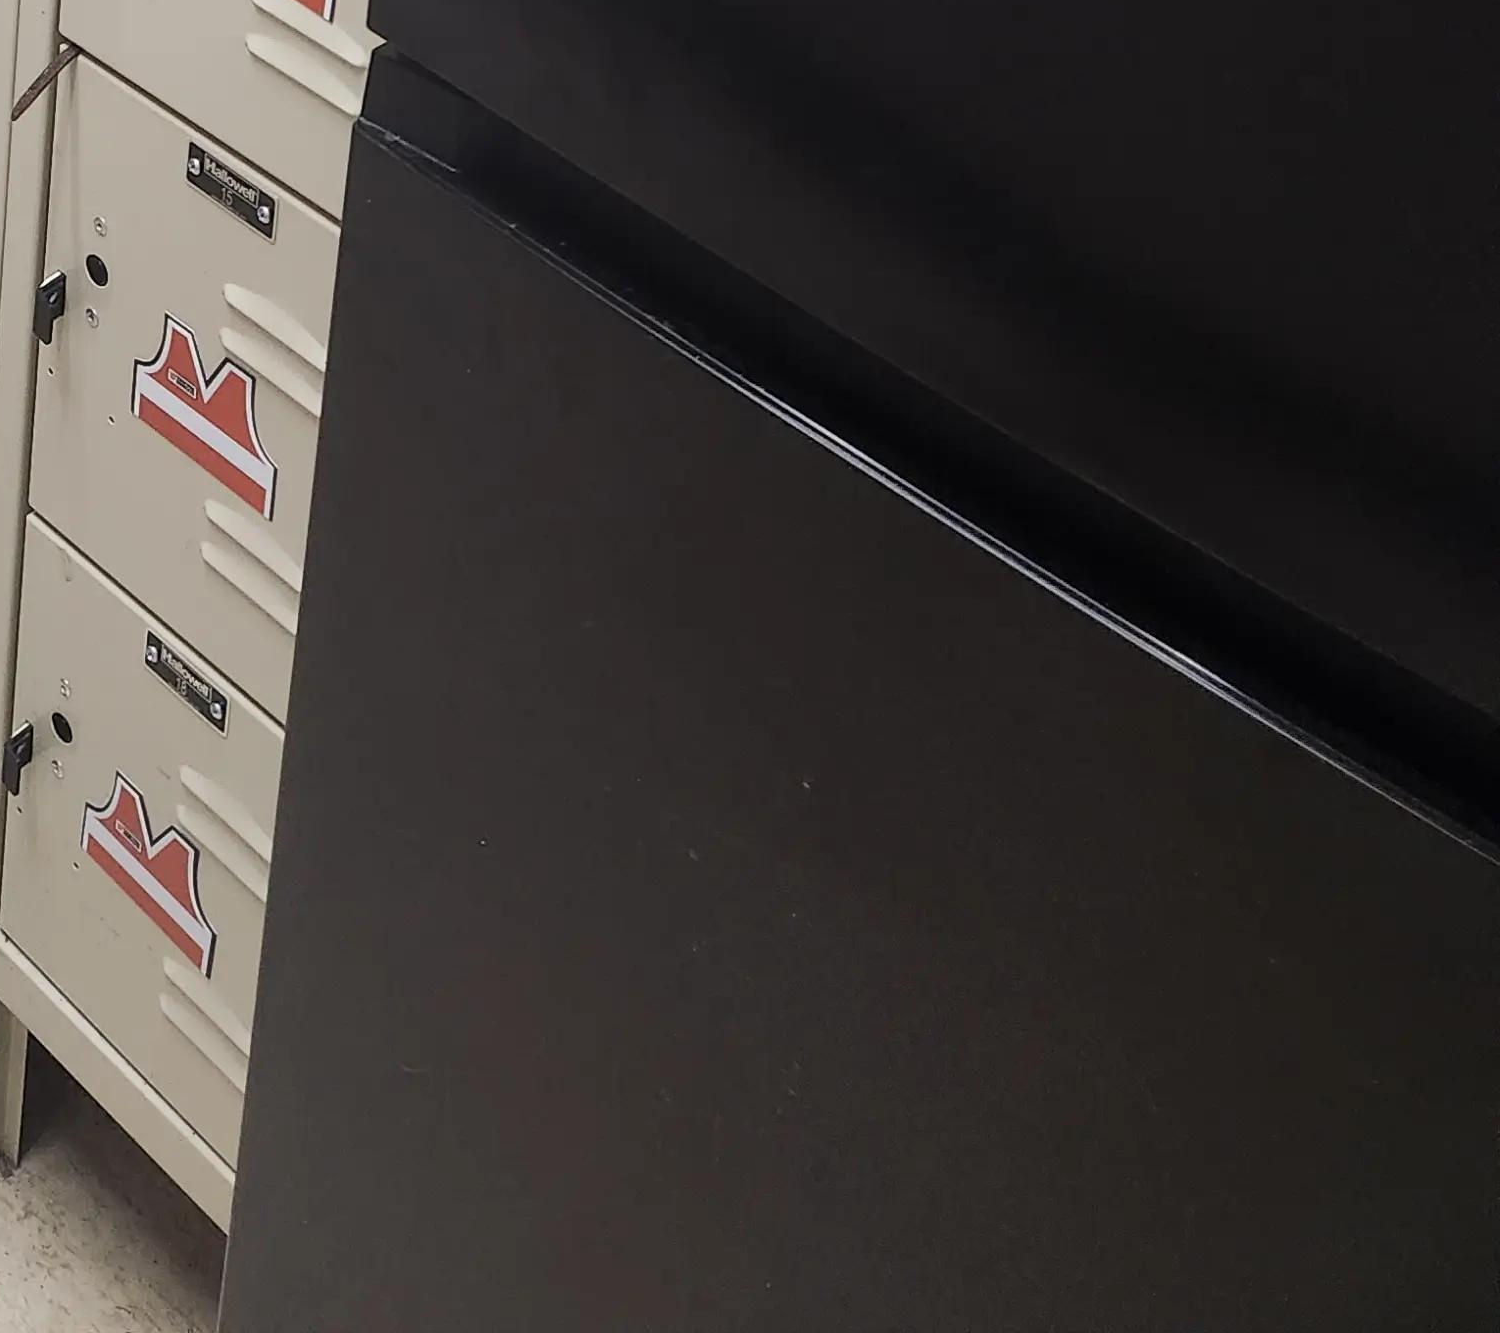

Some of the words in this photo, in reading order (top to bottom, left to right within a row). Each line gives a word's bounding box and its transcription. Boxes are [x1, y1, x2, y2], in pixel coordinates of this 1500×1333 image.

[204, 157, 257, 203] Hallowell
[220, 187, 234, 207] 15
[161, 650, 209, 696] Hallowell
[174, 676, 188, 696] 18
